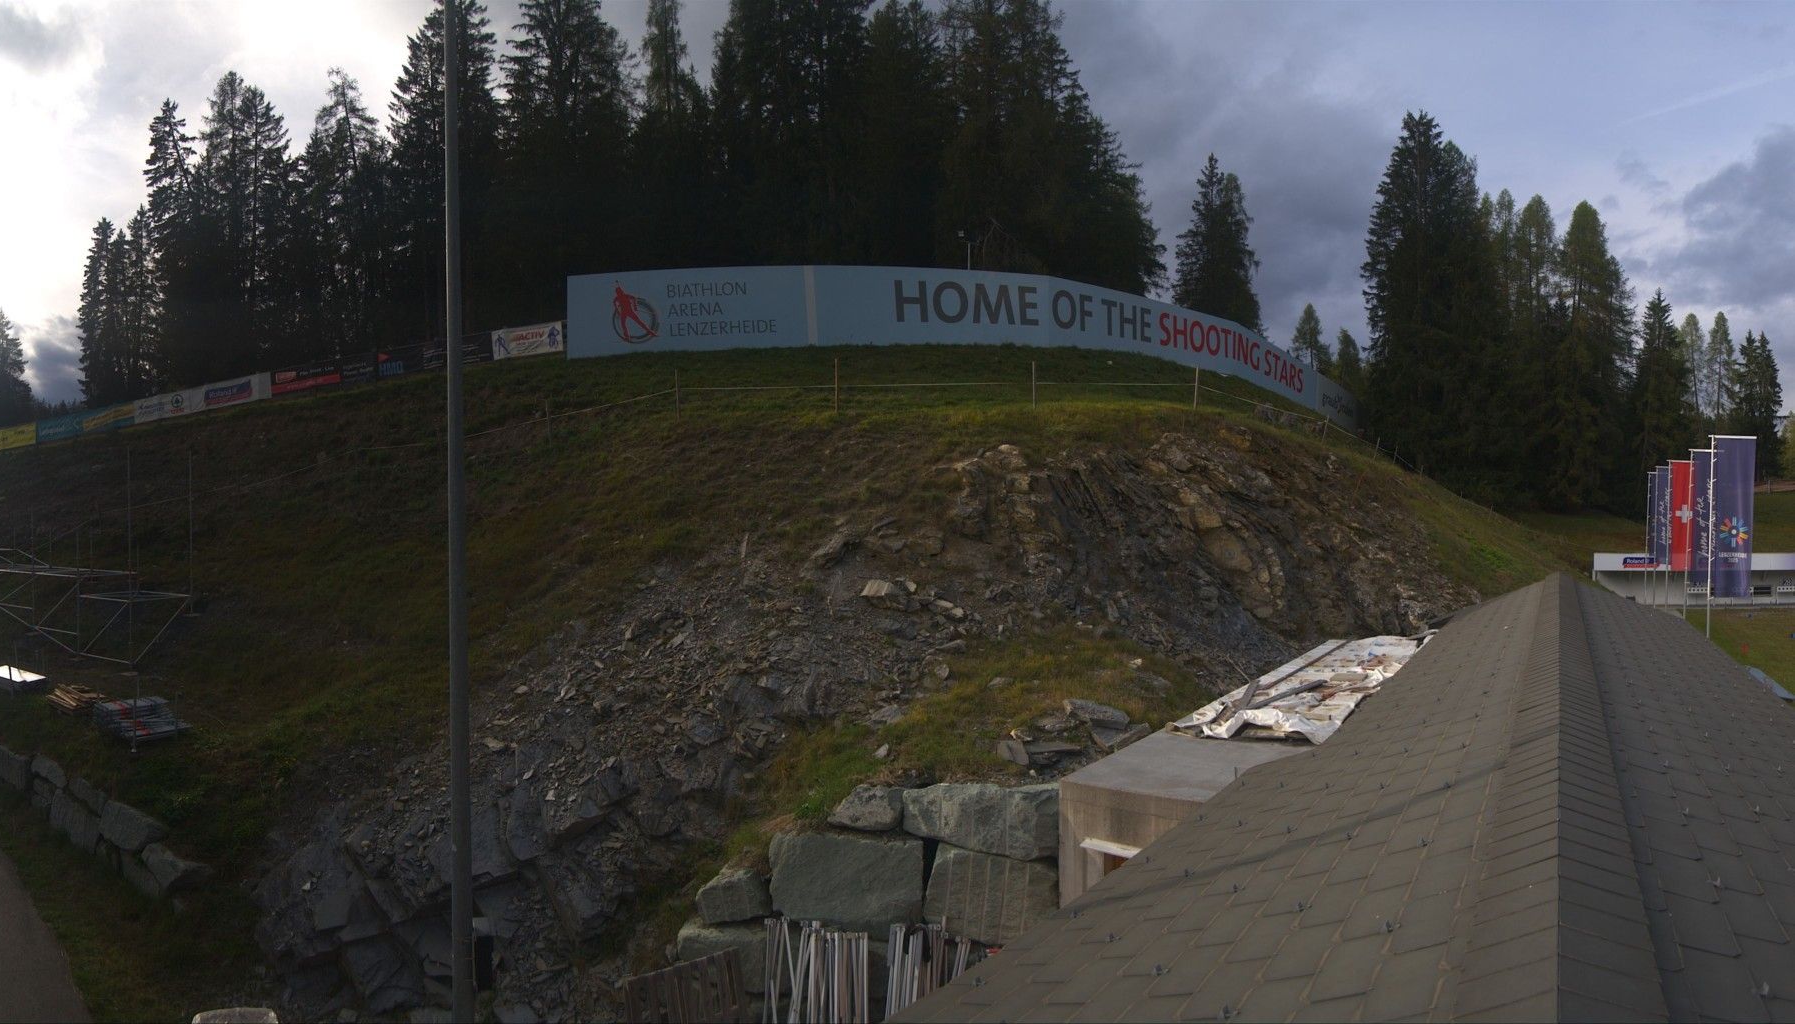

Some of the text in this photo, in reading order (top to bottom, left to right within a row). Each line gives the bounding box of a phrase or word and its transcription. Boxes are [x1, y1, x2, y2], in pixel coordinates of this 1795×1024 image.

[666, 281, 747, 299] BIATHLON
[668, 301, 723, 318] ARENA
[669, 319, 777, 337] LENZERHEIDE
[894, 279, 1304, 393] HOME OF THE SHOOTING STARS
